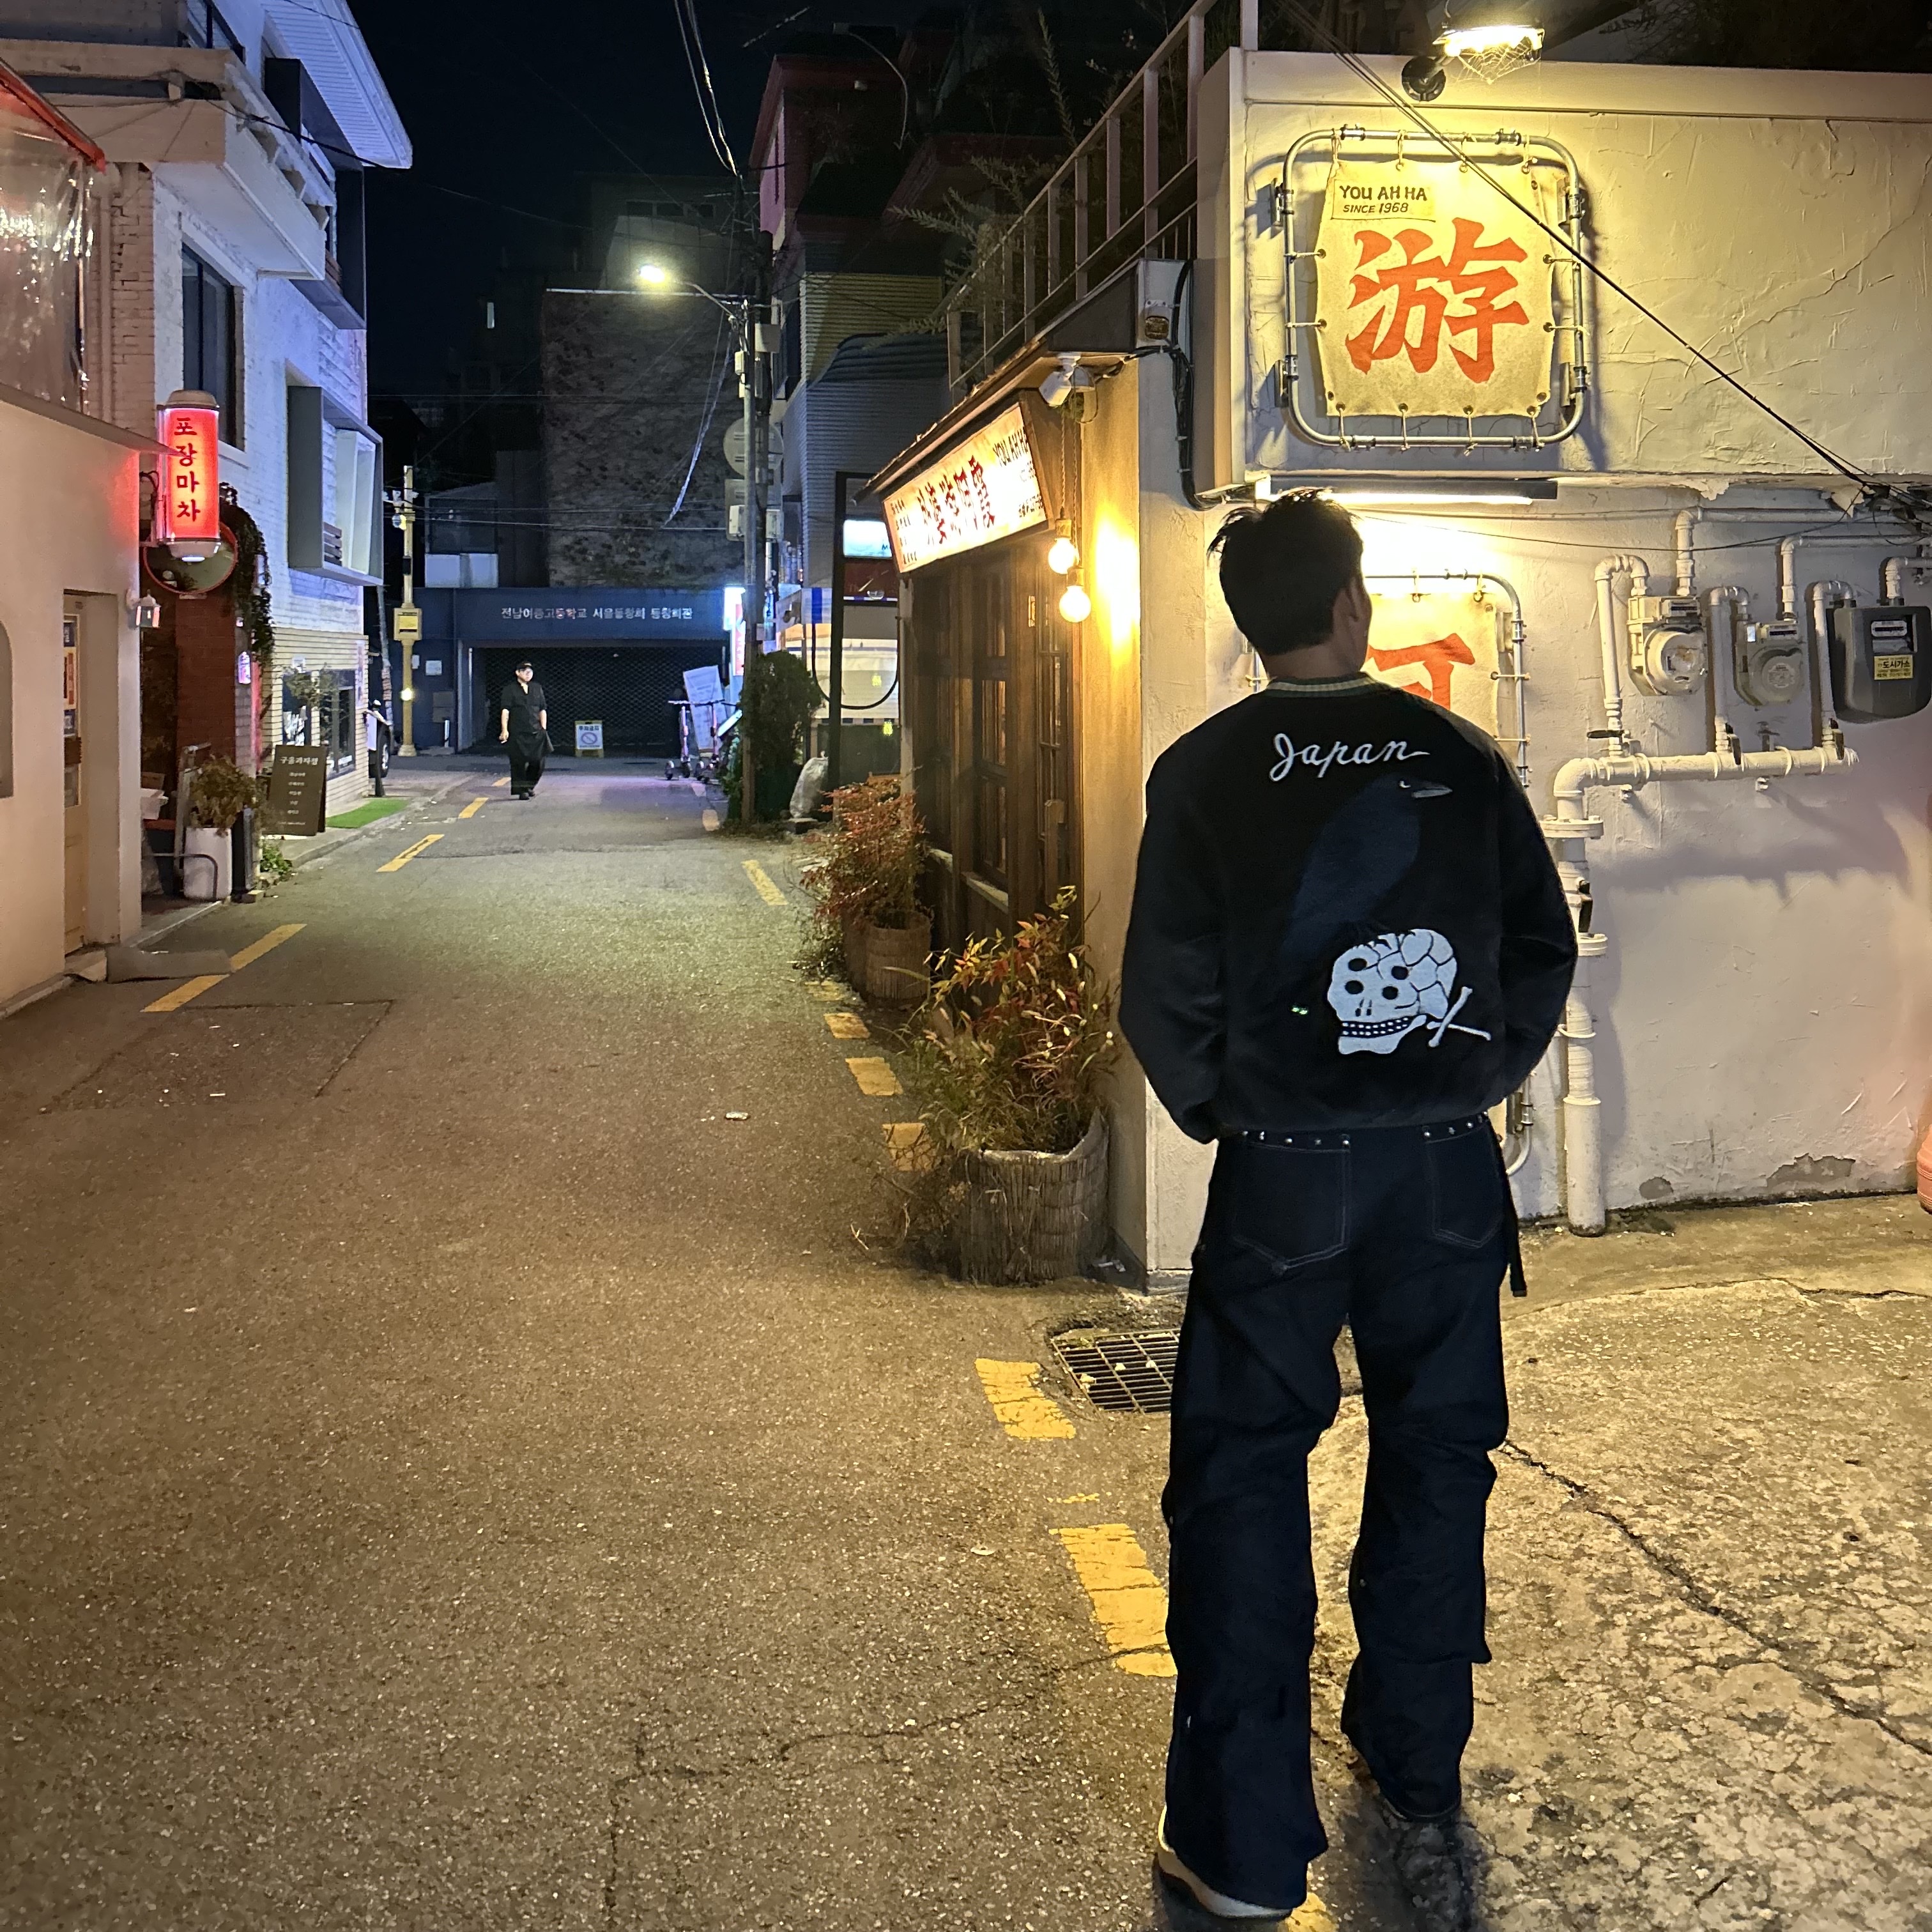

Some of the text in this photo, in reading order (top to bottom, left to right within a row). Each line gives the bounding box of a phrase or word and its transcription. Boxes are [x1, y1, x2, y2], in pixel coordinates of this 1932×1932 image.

[1339, 185, 1428, 201] YOU AH HA
[1343, 202, 1409, 214] SINCE 1968
[1345, 217, 1530, 384] 游
[174, 417, 202, 523] 포장마차
[1268, 733, 1430, 782] Japan
